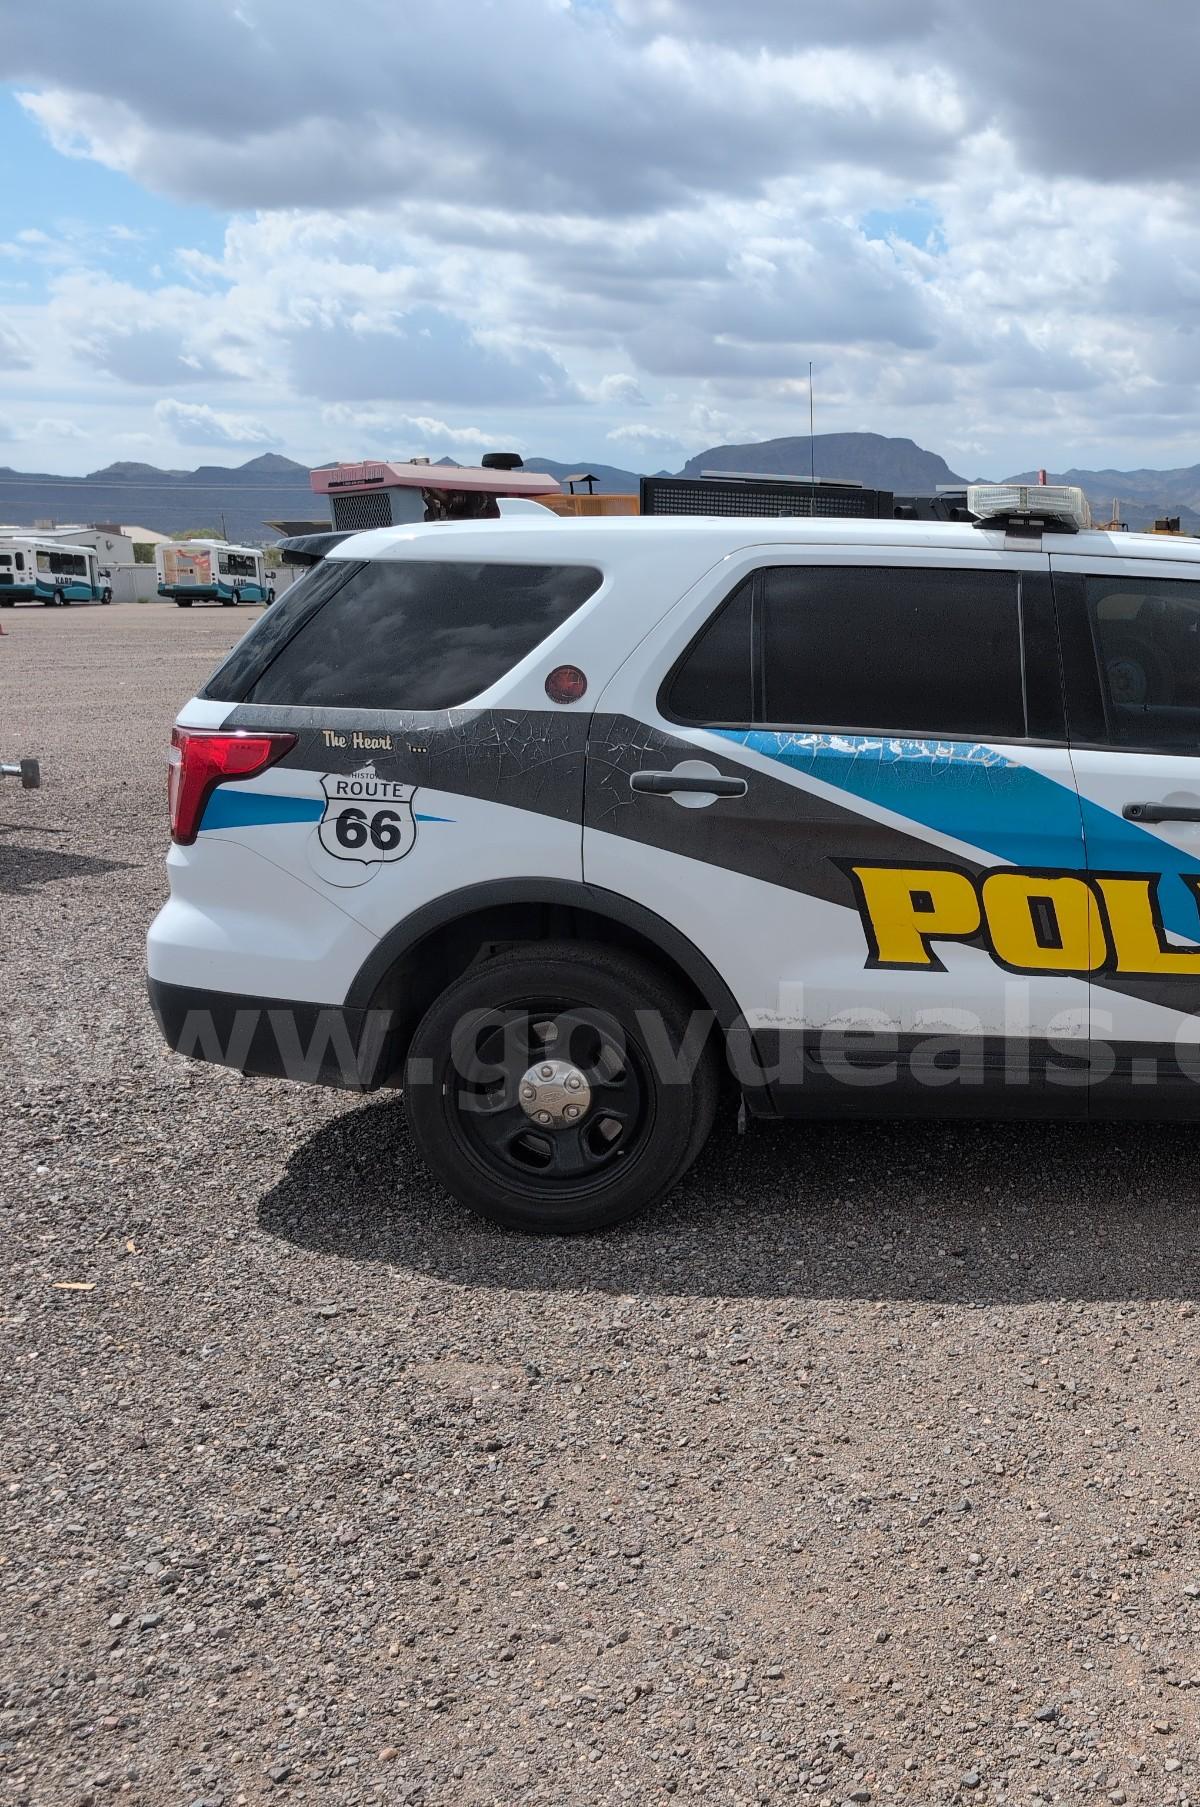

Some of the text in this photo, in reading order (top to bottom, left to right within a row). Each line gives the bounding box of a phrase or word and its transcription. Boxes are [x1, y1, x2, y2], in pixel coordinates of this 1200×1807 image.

[322, 730, 347, 748] The
[352, 731, 393, 750] Heart
[351, 771, 380, 780] HISTO
[336, 781, 404, 798] ROUTE
[335, 807, 402, 851] 66
